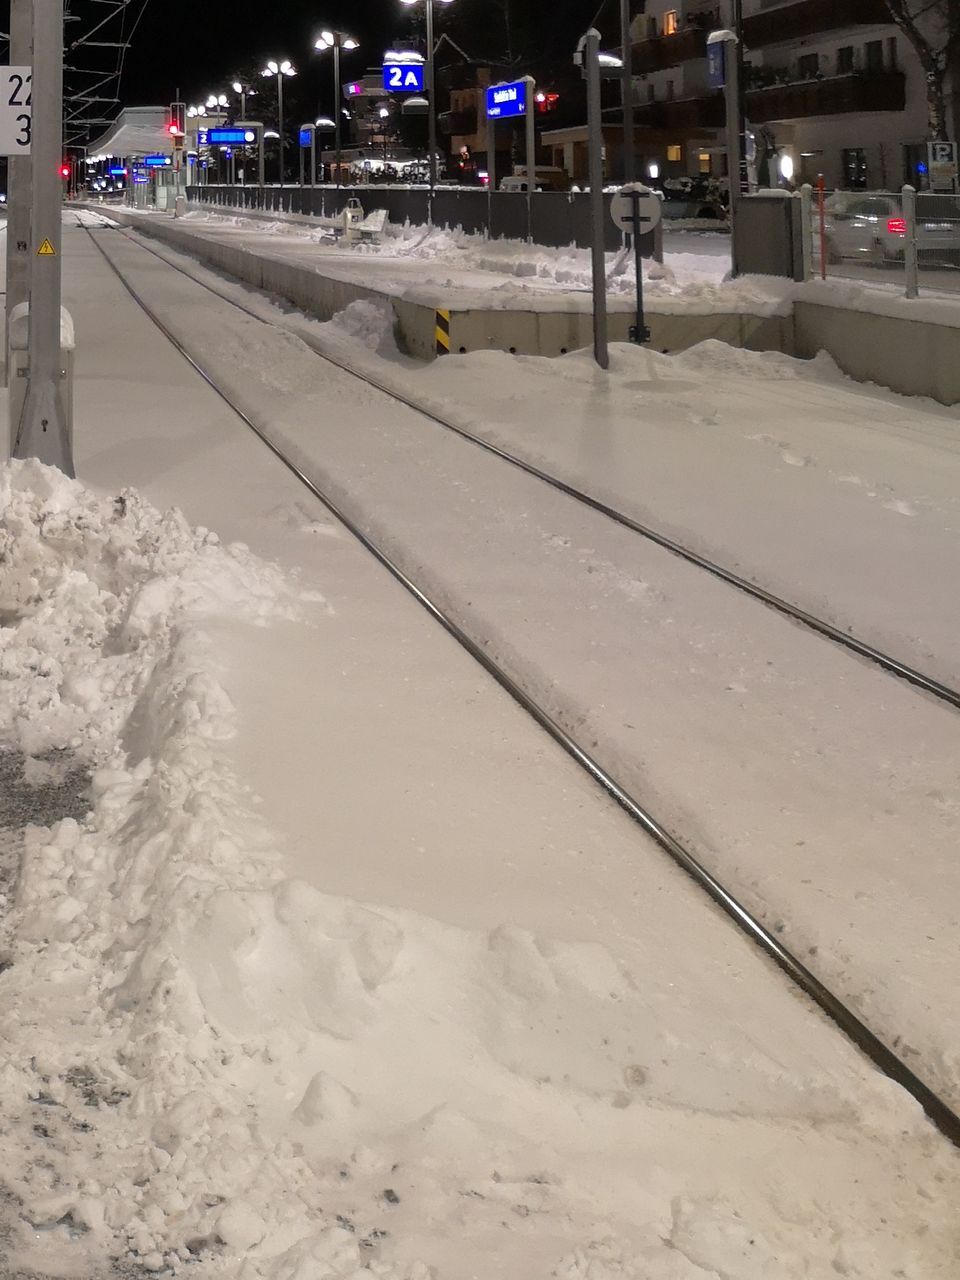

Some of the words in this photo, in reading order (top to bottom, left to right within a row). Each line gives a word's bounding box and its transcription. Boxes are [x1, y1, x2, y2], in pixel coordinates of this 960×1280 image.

[389, 67, 419, 87] 2A
[16, 114, 32, 146] 3
[200, 134, 208, 144] 2
